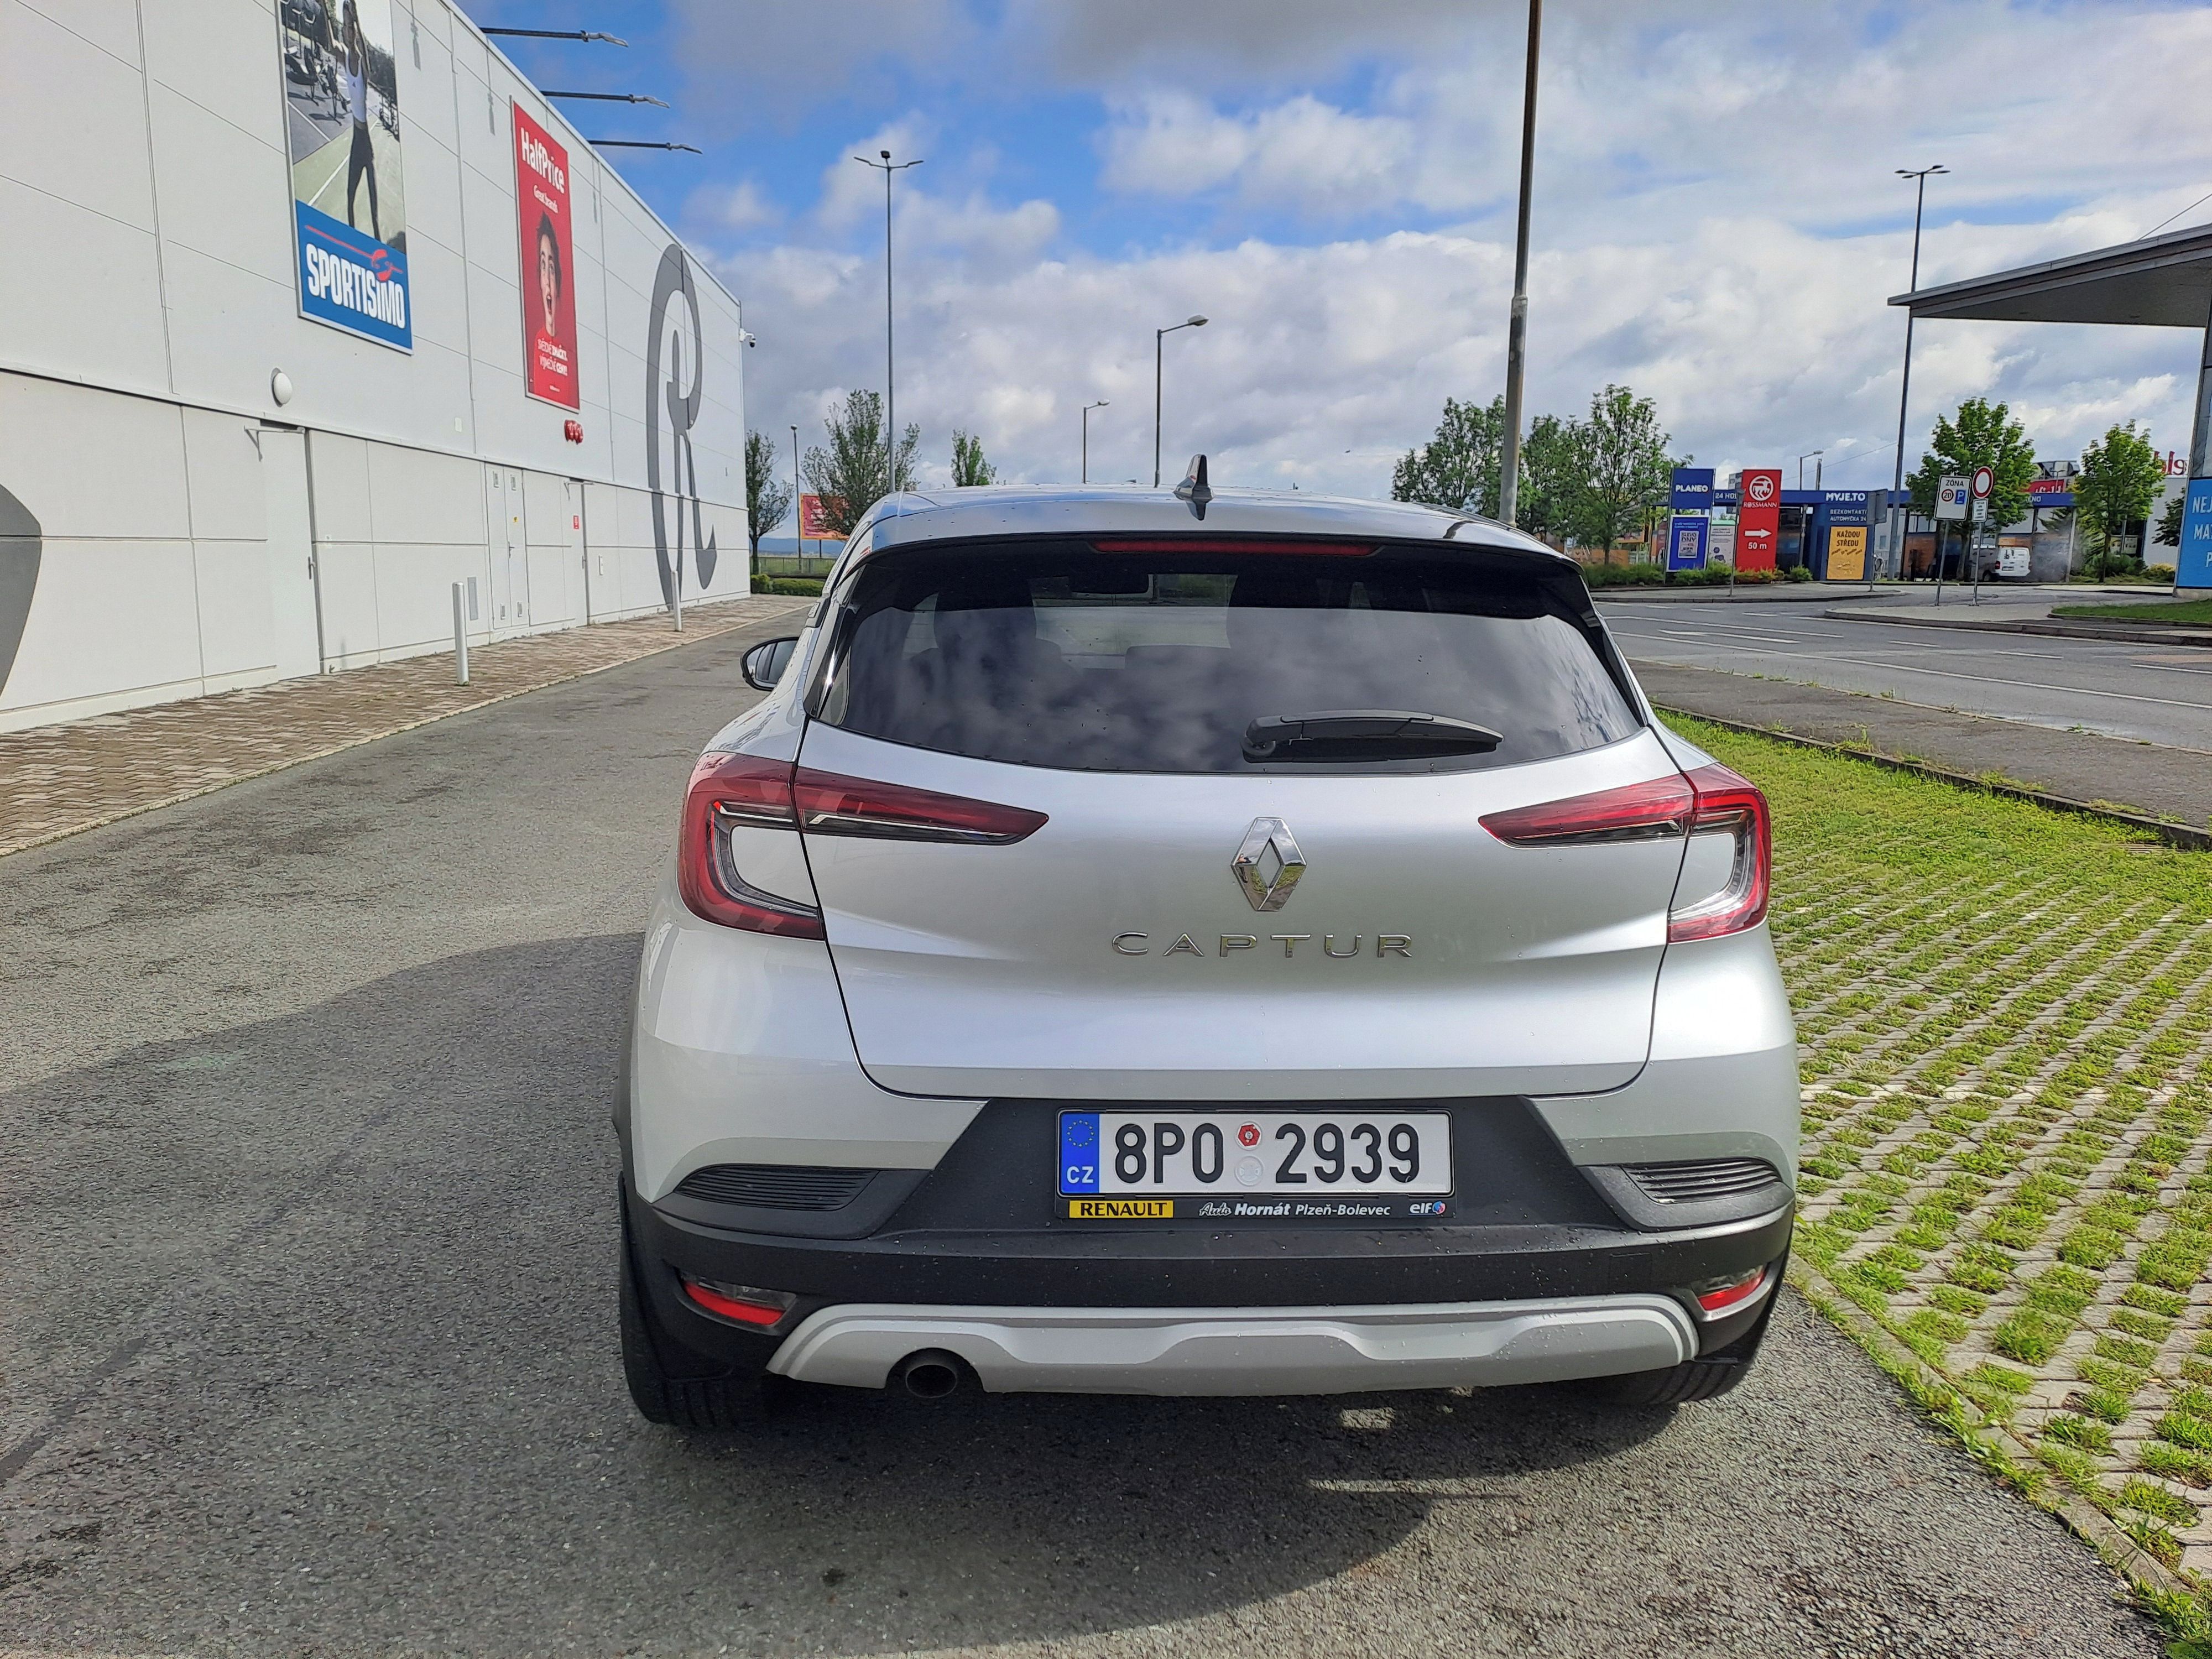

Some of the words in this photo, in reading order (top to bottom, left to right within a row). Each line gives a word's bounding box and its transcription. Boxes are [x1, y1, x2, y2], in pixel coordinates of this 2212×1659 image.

[520, 127, 565, 194] HalfPrice
[306, 243, 405, 328] SPORTISIMO
[1675, 484, 1709, 493] PLANEO
[1825, 492, 1866, 502] MYJE.TO
[1837, 529, 1860, 538] KAŽDOU
[2193, 523, 2212, 540] MA
[1836, 539, 1859, 547] STŘEDU
[1112, 931, 1413, 958] CAPTUR
[1276, 1123, 1419, 1183] 2939
[1067, 1166, 1094, 1183] CZ
[1080, 1202, 1167, 1216] RENAULT
[1198, 1202, 1232, 1217] Auto
[1234, 1202, 1291, 1216] Hornát
[1295, 1204, 1391, 1216] Plzeň-Bolevec
[1410, 1202, 1432, 1214] elf
